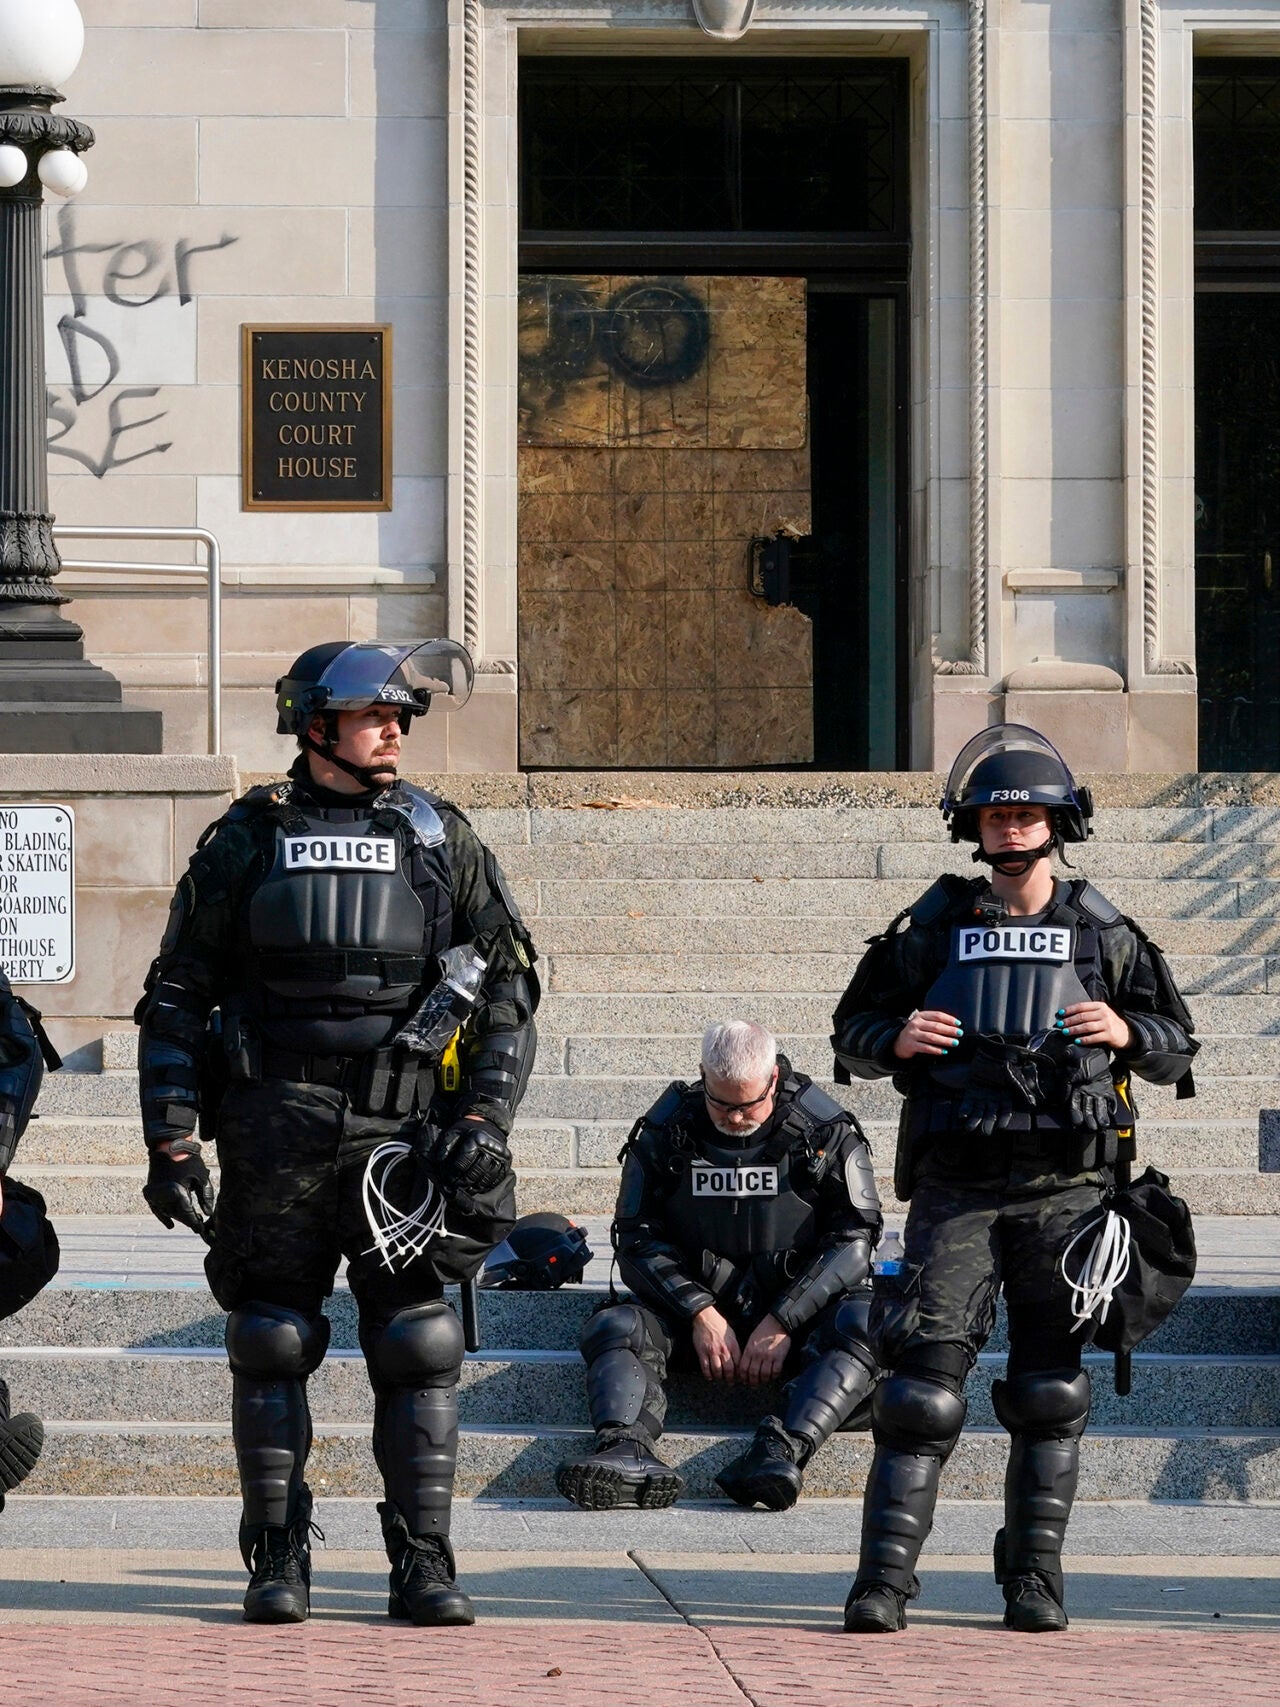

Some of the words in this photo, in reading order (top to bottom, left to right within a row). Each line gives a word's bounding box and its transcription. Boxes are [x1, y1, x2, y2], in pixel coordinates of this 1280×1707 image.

[262, 358, 376, 380] KENOSHA
[270, 391, 367, 412] COUNTY
[279, 424, 356, 445] COURT
[278, 457, 357, 478] HOUSE
[381, 689, 413, 702] F302
[990, 789, 1030, 802] F306
[0, 811, 18, 829] NO
[291, 841, 390, 864] POLICE
[8, 854, 68, 871] SKATING
[0, 875, 18, 893] OR
[0, 917, 18, 935] ON
[964, 931, 1064, 954] POLICE
[1, 960, 44, 978] PERTY
[696, 1172, 773, 1192] POLICE
